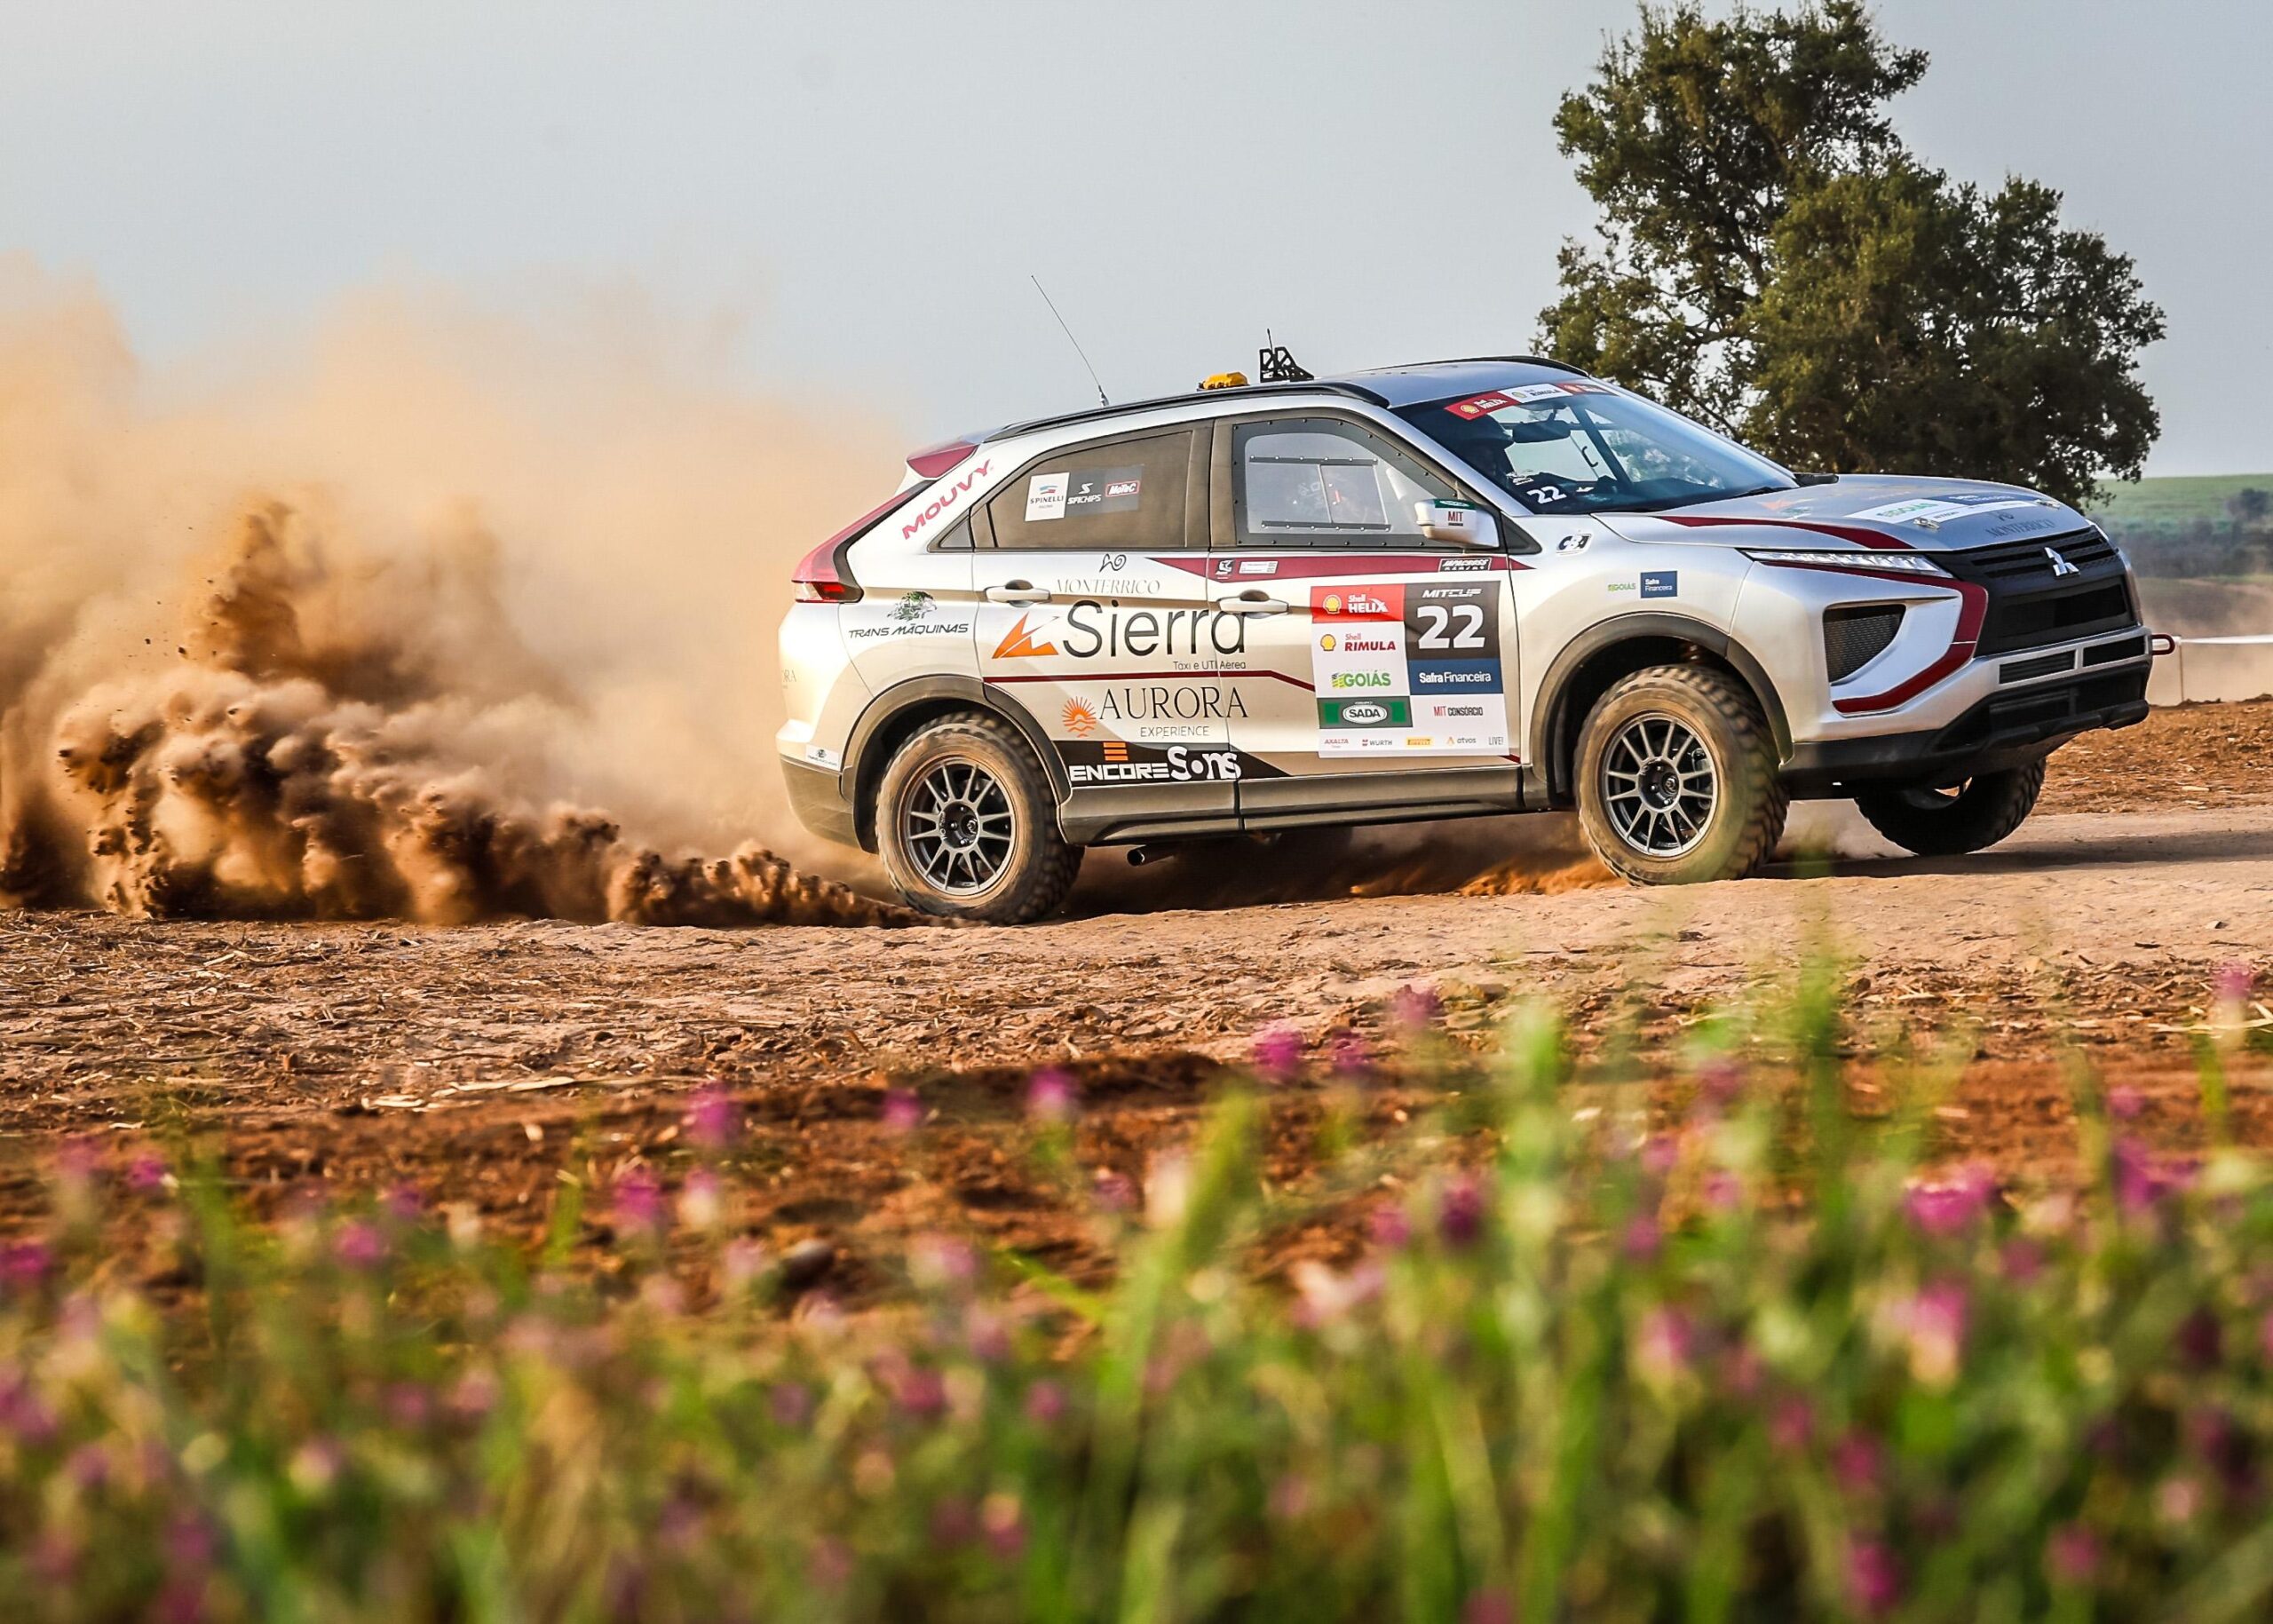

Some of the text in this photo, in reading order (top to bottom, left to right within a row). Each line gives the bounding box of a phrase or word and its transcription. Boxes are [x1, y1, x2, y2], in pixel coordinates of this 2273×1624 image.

[901, 458, 991, 540] MOUVY
[1030, 495, 1064, 504] SPINELLI
[1526, 486, 1567, 504] 22
[1448, 511, 1463, 522] MIT
[1055, 578, 1160, 595] MONTERRICO
[1348, 593, 1366, 602] Shell
[1348, 598, 1389, 613] HELIX
[849, 627, 890, 638] TRANS
[1063, 598, 1246, 658] Sierra
[1417, 605, 1486, 650] 22
[1344, 641, 1396, 651] RIMULA
[1173, 661, 1192, 670] Taxi
[1201, 660, 1218, 669] UTI
[1343, 669, 1391, 687] GOIÁS
[1419, 670, 1492, 684] Safra Financeira
[1099, 686, 1248, 720] AURORA
[1349, 709, 1381, 718] SADA
[1433, 705, 1446, 717] MIT
[1140, 725, 1209, 738] EXPERIENCE
[1068, 762, 1170, 782] ENCORE
